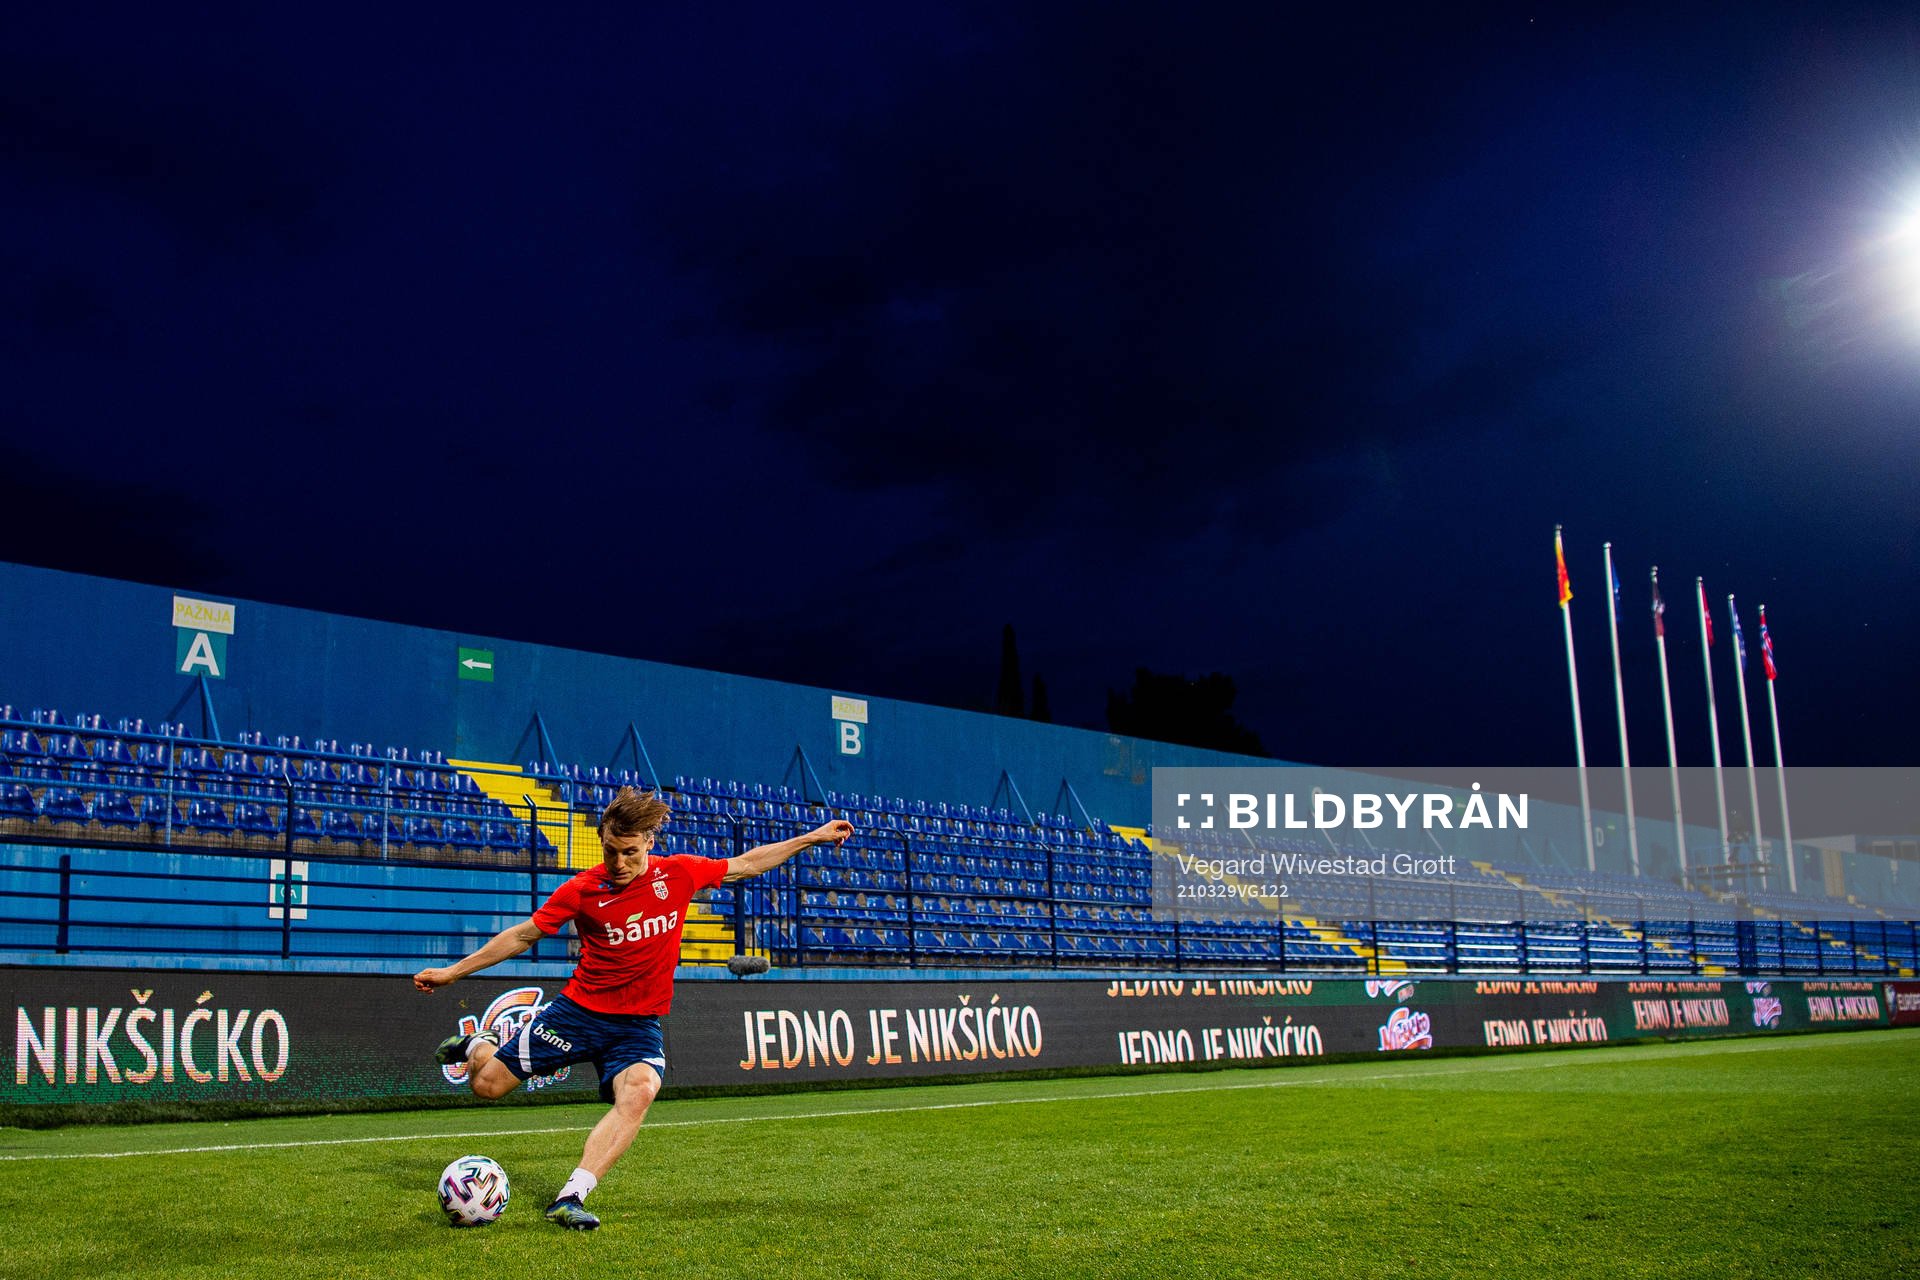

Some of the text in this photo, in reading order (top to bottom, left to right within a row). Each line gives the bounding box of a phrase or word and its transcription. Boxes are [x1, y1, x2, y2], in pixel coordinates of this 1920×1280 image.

[175, 602, 232, 624] PAŽNJA
[181, 632, 220, 676] A
[841, 721, 861, 755] B
[16, 989, 289, 1084] NIKŠIĆKO
[739, 994, 1042, 1070] JEDNO JE NIKŠIĆKO
